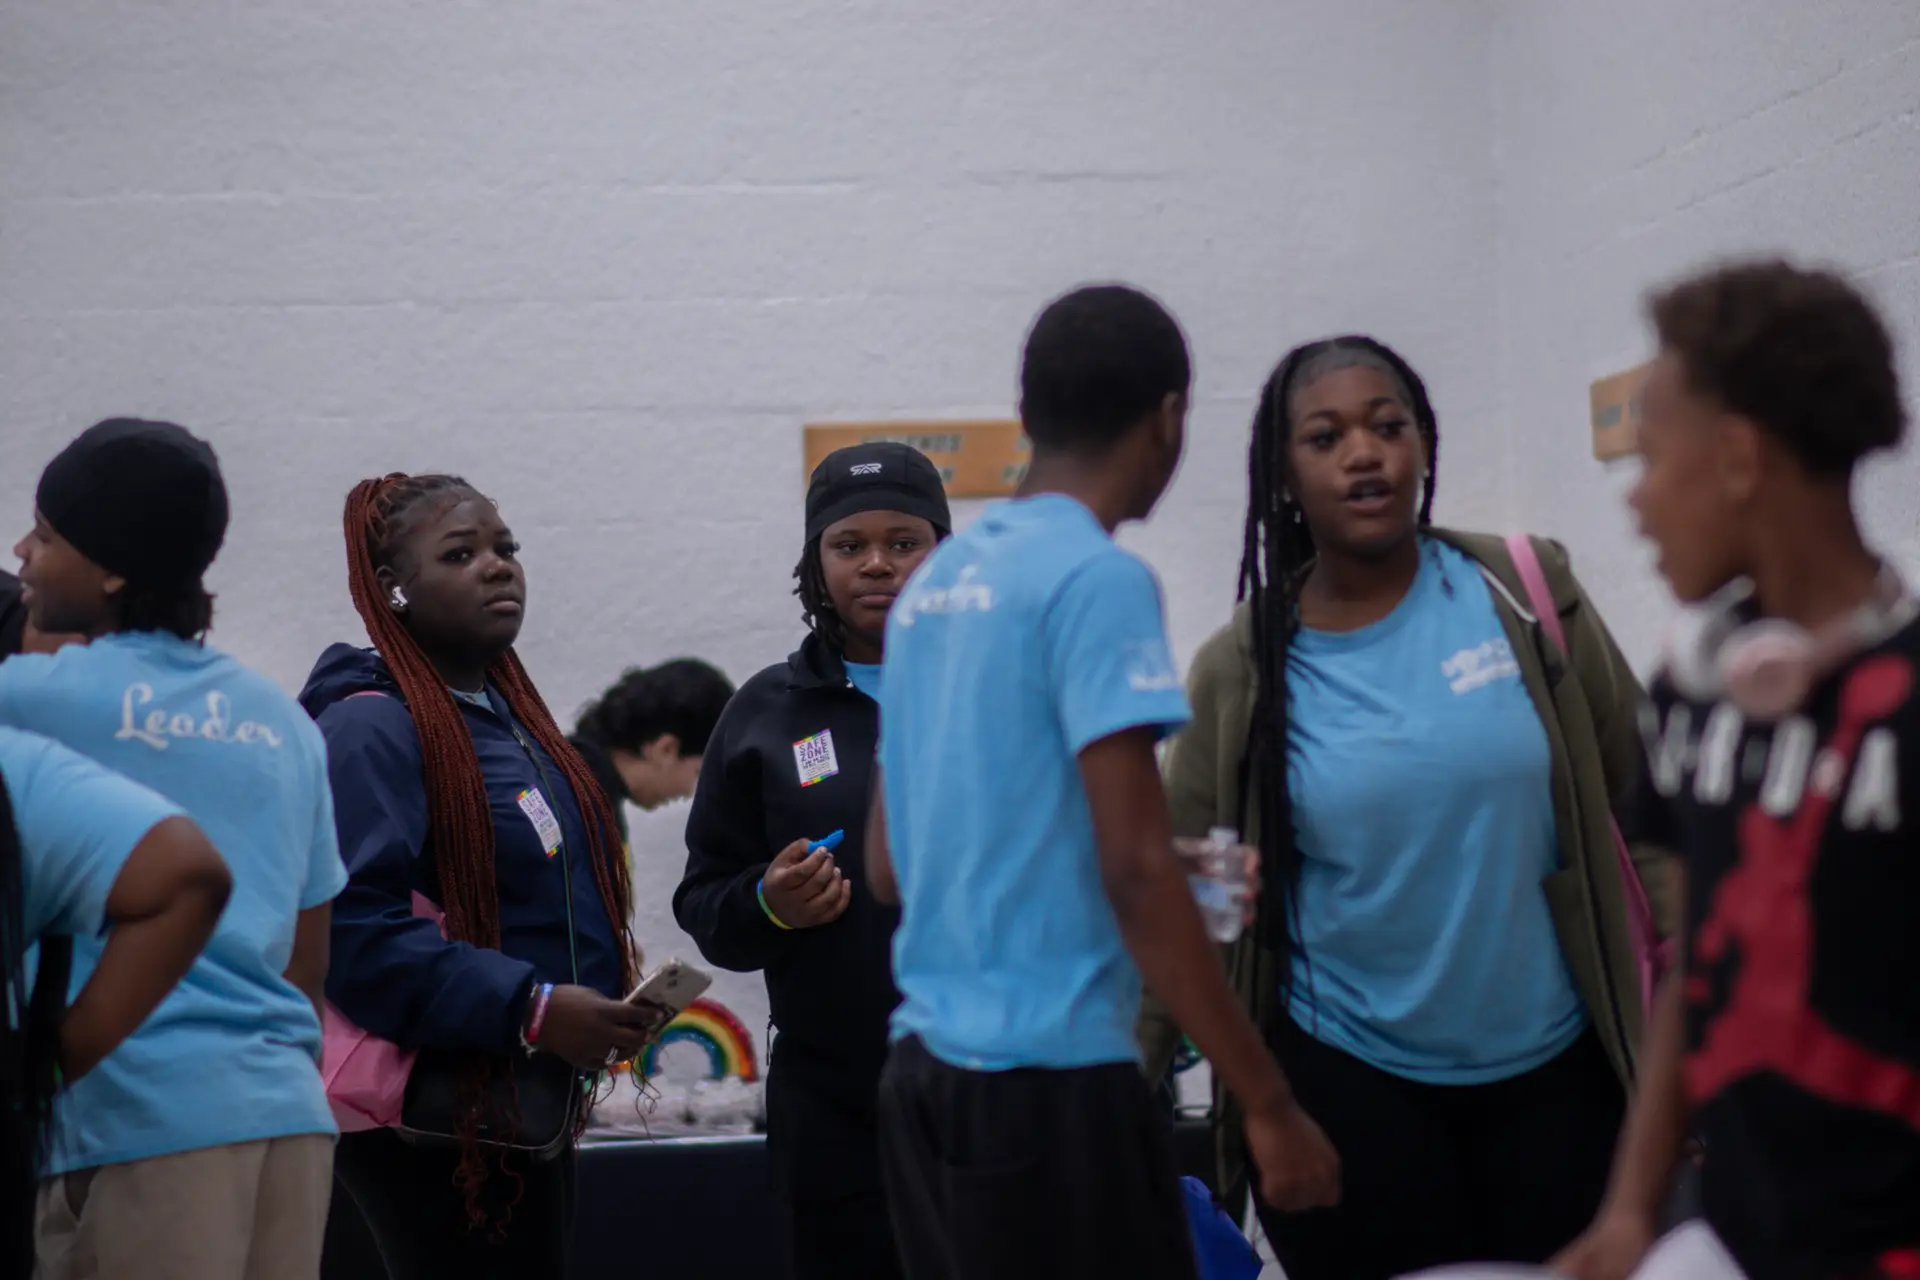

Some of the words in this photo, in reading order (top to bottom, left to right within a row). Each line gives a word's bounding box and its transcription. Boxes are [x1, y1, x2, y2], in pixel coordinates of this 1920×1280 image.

[114, 682, 282, 750] Leader
[799, 736, 826, 753] SAFE
[800, 745, 829, 762] ZONE
